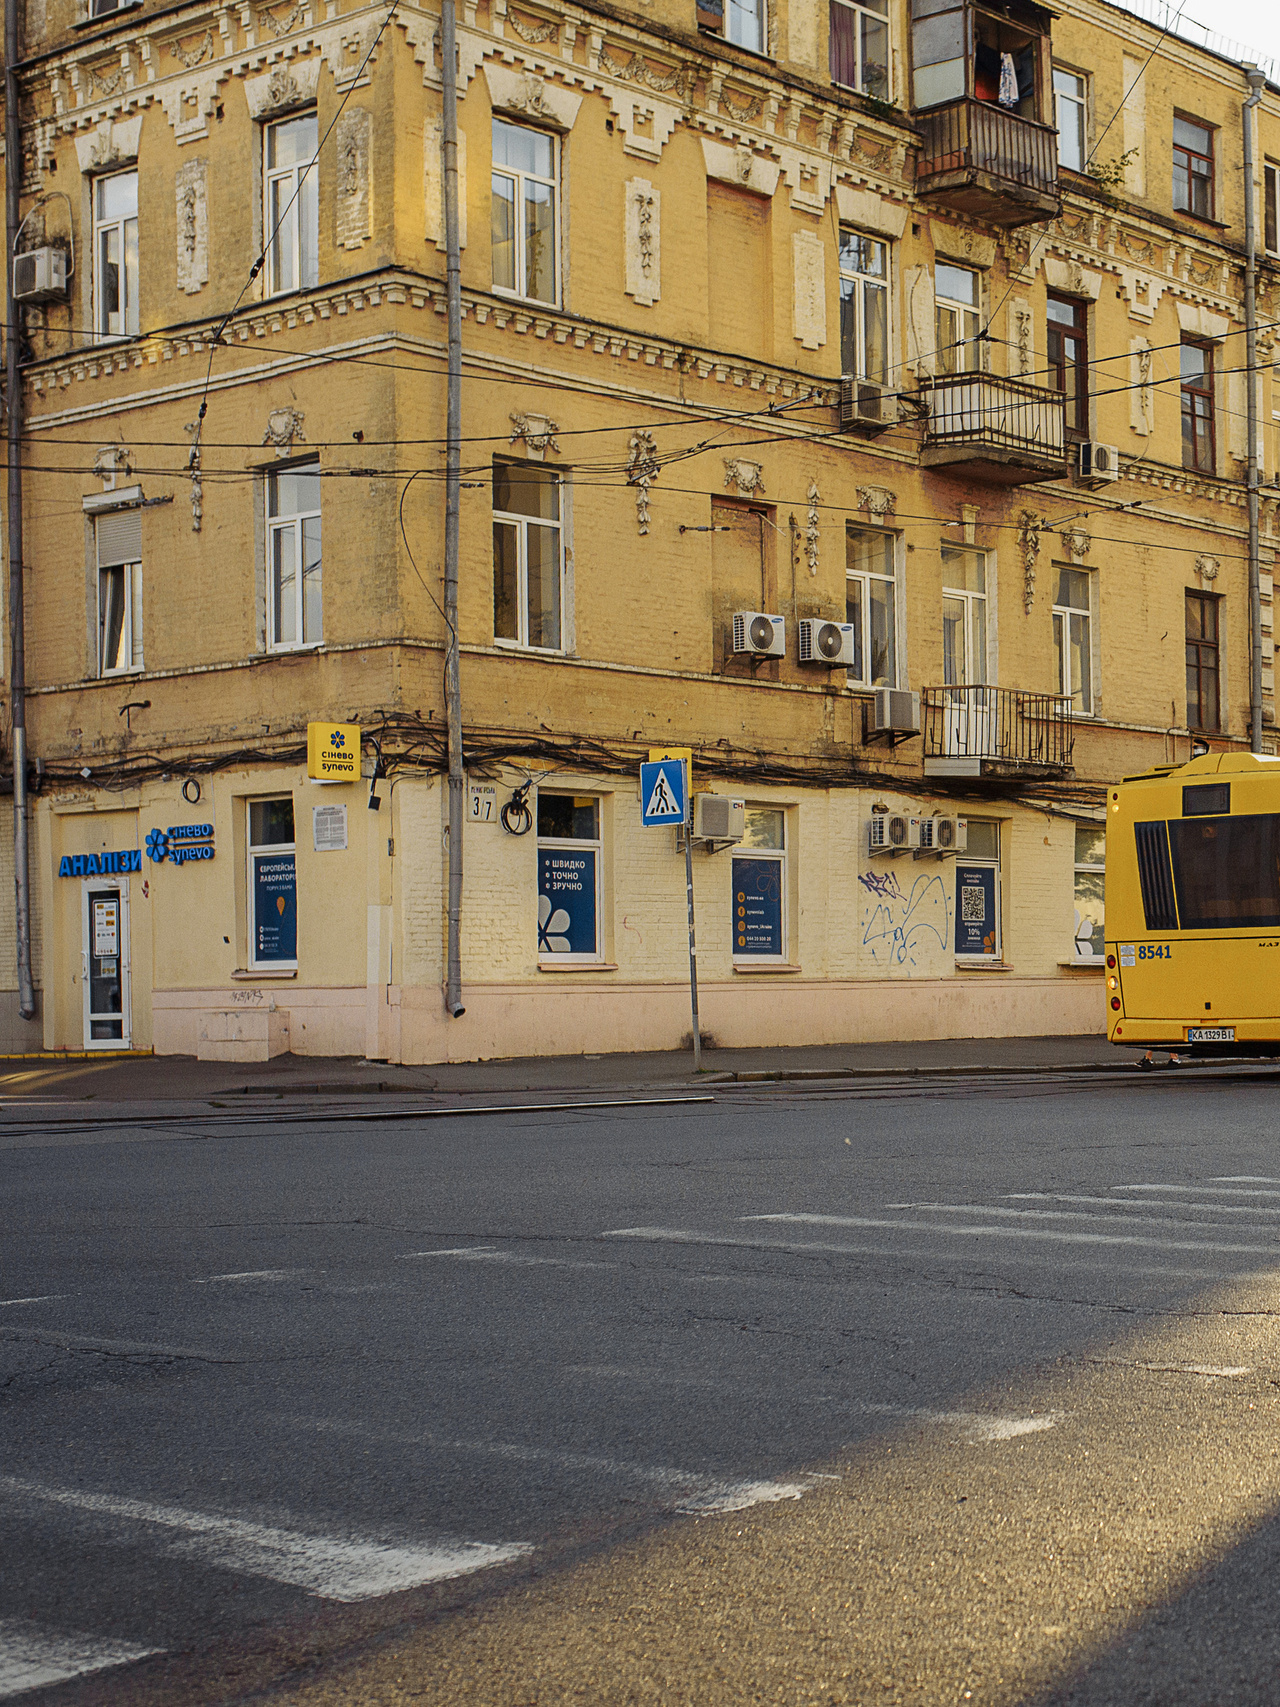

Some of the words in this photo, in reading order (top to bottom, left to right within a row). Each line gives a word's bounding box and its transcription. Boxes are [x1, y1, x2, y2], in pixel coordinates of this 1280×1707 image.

[322, 763, 354, 772] synevo
[168, 846, 215, 866] synevo
[58, 849, 143, 878] АНАЛІЗИ
[552, 860, 586, 870] ШВИДКО
[552, 871, 579, 880] ТОЧНО
[552, 882, 583, 891] ЗРУЧНО
[1138, 944, 1172, 960] 8541
[1204, 1030, 1221, 1040] 1329
